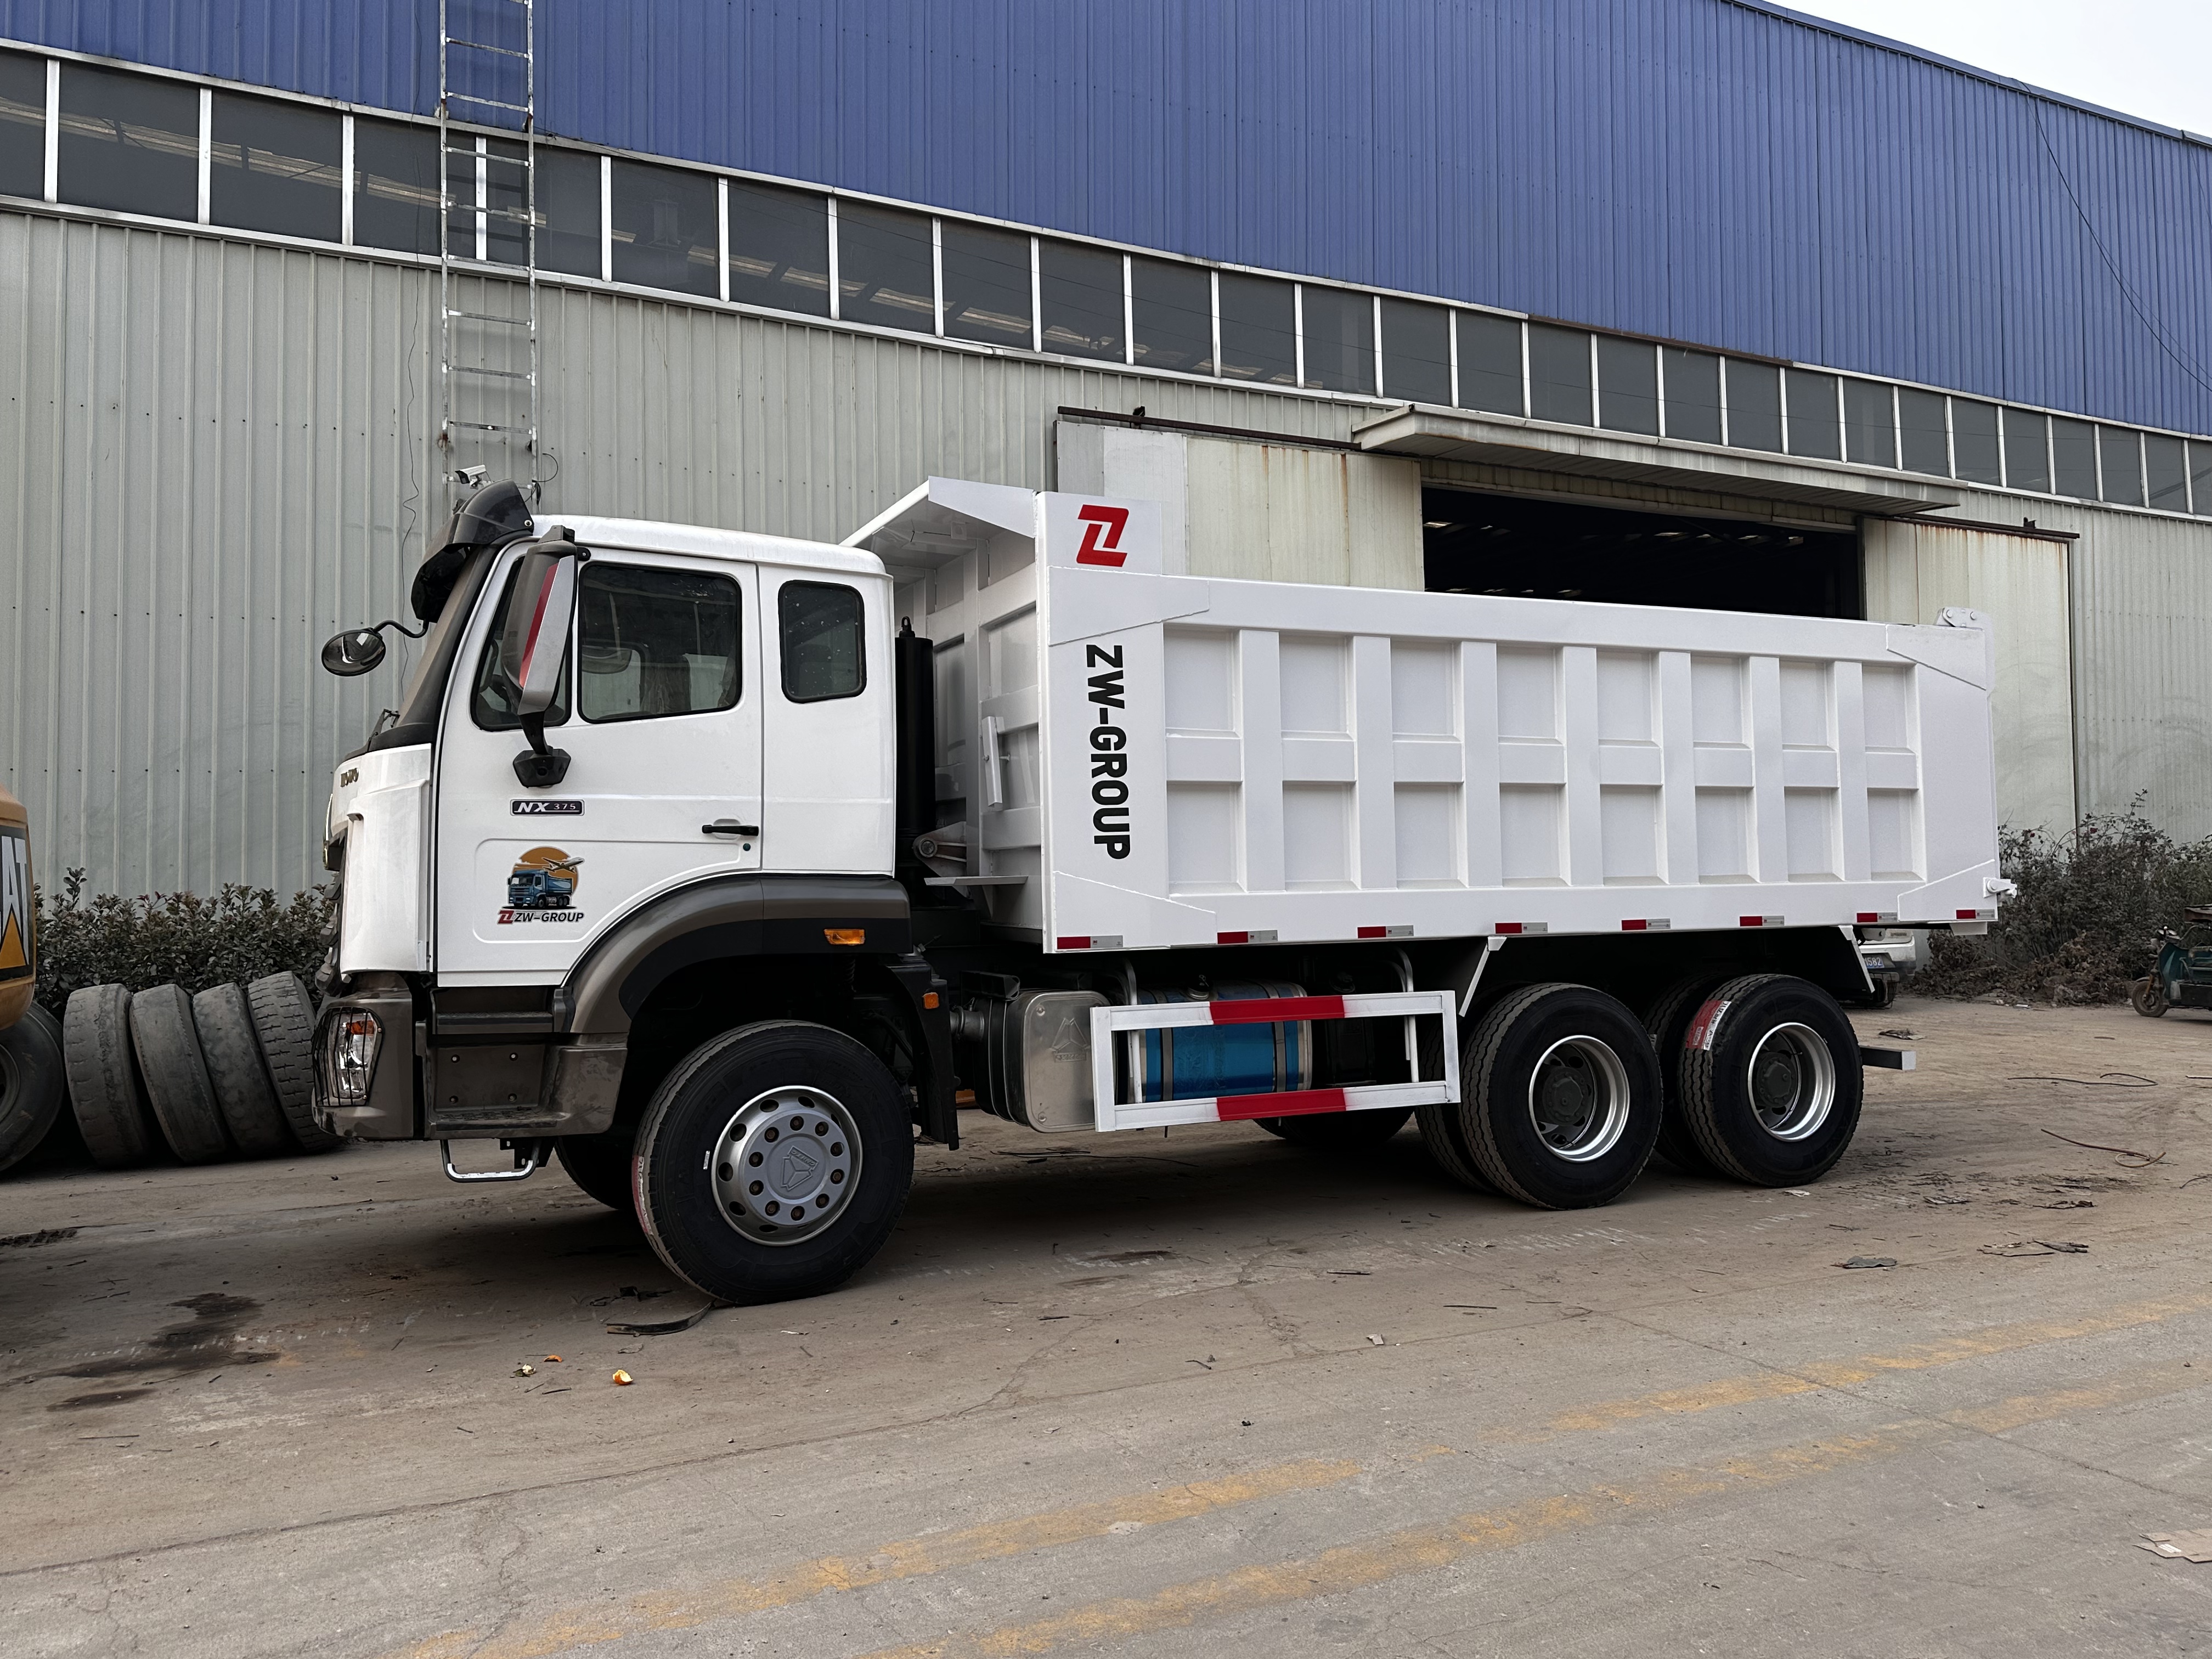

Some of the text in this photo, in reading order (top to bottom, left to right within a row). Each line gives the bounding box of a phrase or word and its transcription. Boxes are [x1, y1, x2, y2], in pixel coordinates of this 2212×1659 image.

[1086, 644, 1131, 860] ZW-GROUP
[515, 802, 550, 812] NX
[0, 836, 29, 965] AT
[514, 912, 584, 922] ZW-GROUP
